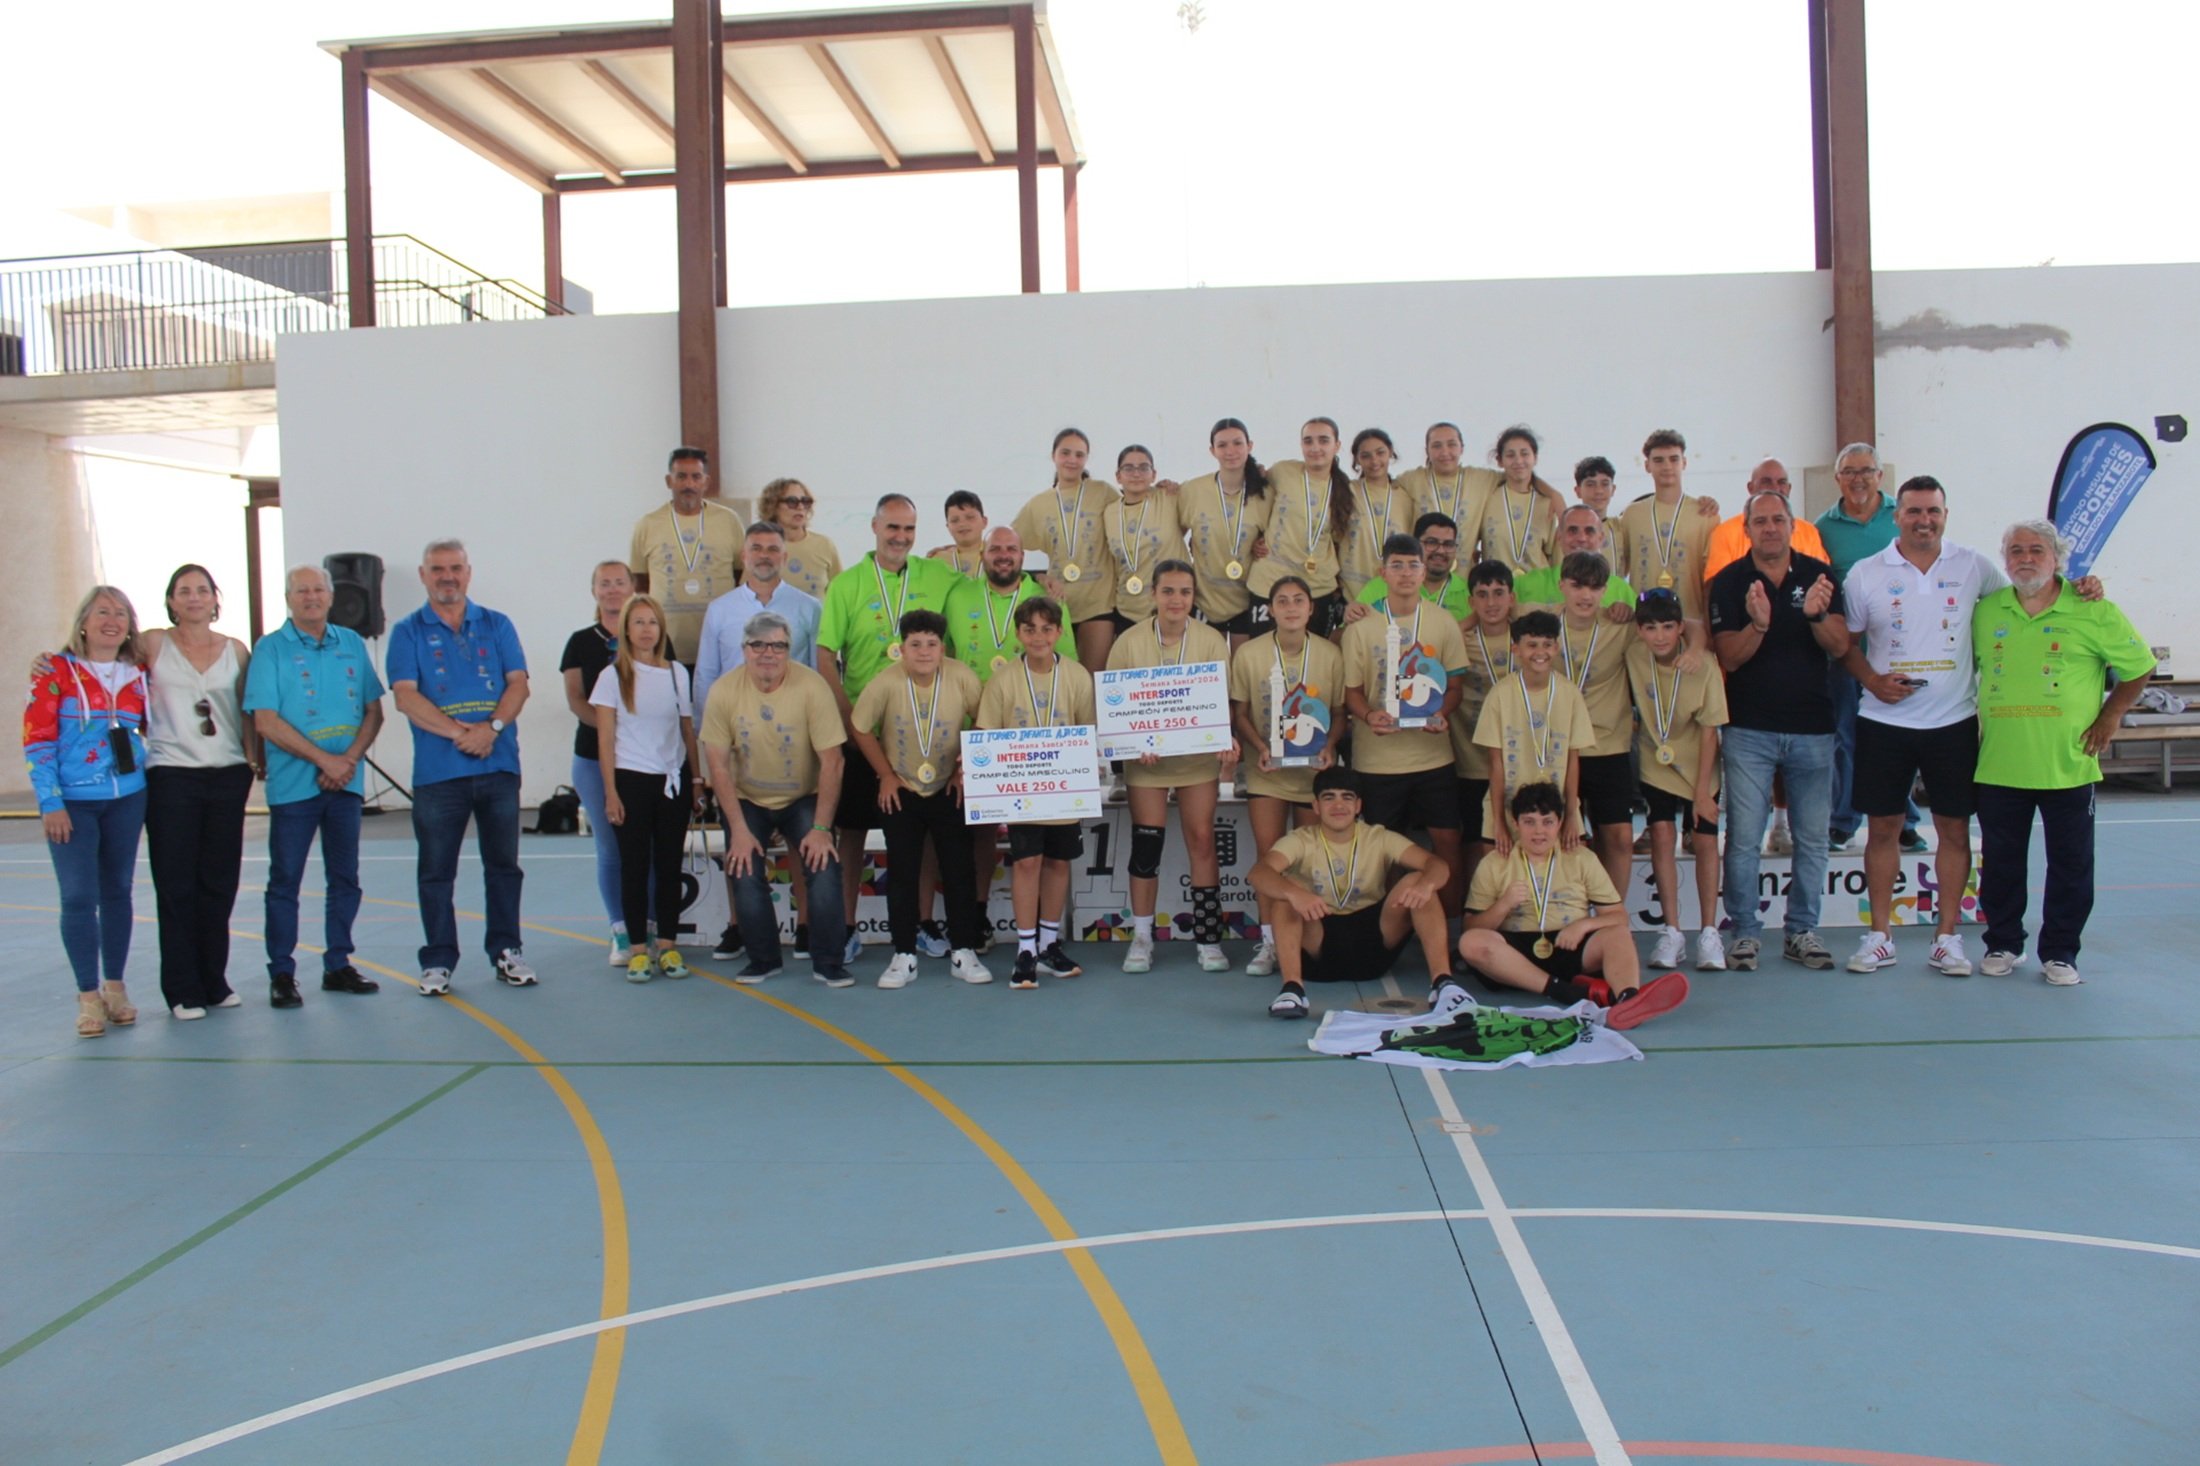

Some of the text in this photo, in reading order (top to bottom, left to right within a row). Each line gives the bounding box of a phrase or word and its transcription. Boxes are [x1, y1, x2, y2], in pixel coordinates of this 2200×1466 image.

[2060, 498, 2086, 538] ERVICIO
[2084, 457, 2111, 498] INSULAR
[2109, 442, 2121, 458] DE
[2078, 514, 2102, 551] CABILDO
[2109, 458, 2142, 504] LANZAROTE
[1252, 604, 1269, 624] 12
[1102, 672, 1118, 684] III
[1141, 681, 1170, 689] Semana
[1129, 688, 1191, 701] INTERSPORT
[1108, 703, 1217, 718] CAMPEÓN FEMENINO
[1129, 716, 1198, 731] VALE 250 €
[968, 733, 985, 744] III
[1009, 742, 1039, 750] Semana
[997, 751, 1060, 763] INTERSPORT
[972, 767, 1090, 780] CAMPEÓN MASCULINO
[996, 780, 1068, 793] VALE 250 €
[1086, 822, 1115, 876] 1
